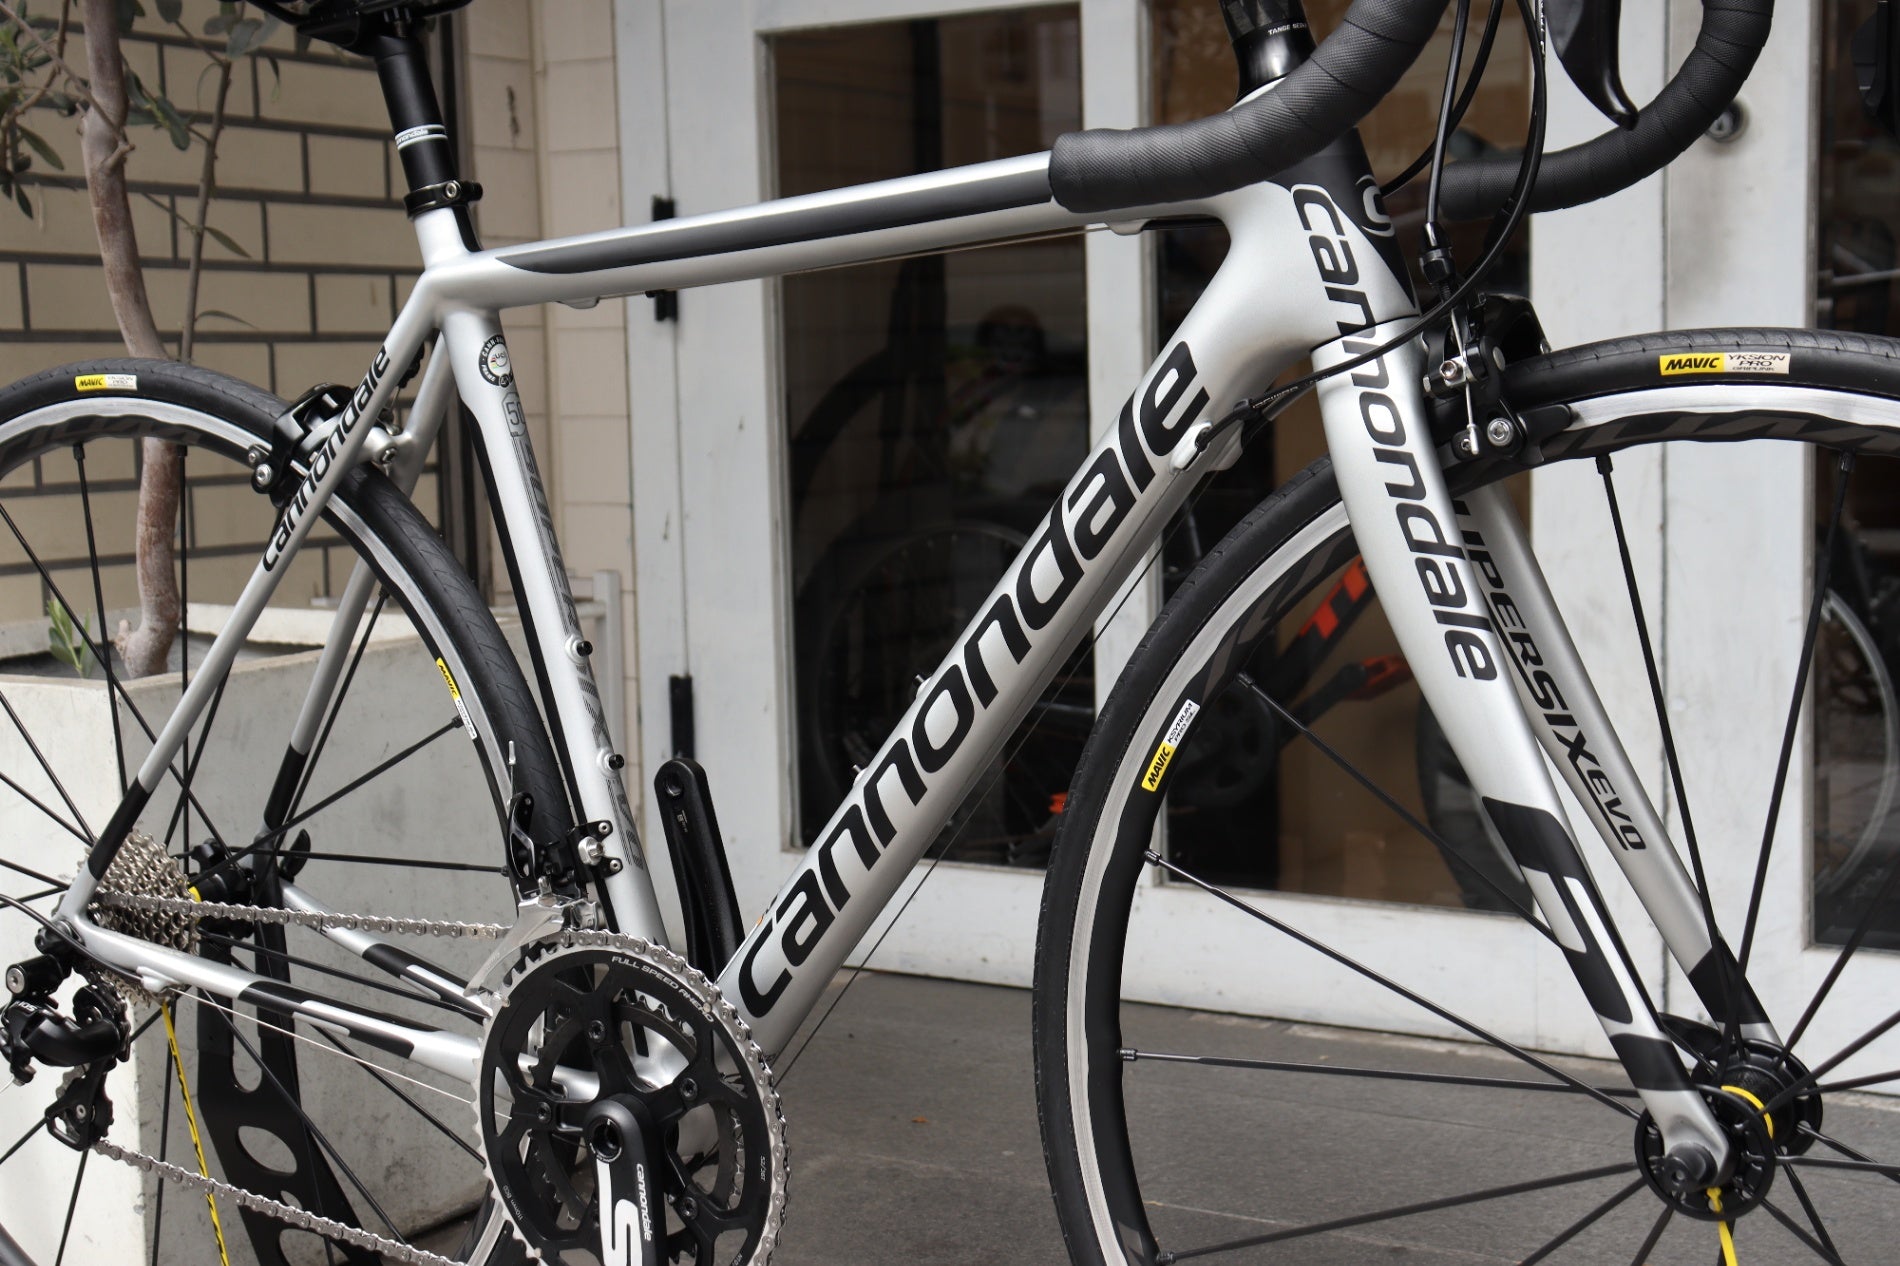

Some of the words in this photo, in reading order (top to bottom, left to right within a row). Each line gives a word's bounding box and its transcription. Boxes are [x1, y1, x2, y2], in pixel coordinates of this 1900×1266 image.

[78, 377, 104, 387] MAVIC
[1665, 356, 1720, 371] MAVIC
[1292, 188, 1498, 682] cannondale
[262, 345, 391, 572] cannondale
[438, 664, 458, 696] MAVIC
[737, 340, 1210, 1018] cannondale
[1167, 702, 1193, 744] KSYRIUM
[1147, 746, 1171, 788] MAVIC
[611, 955, 640, 969] FULL
[641, 964, 679, 990] SPEED
[636, 1163, 652, 1242] cannondale
